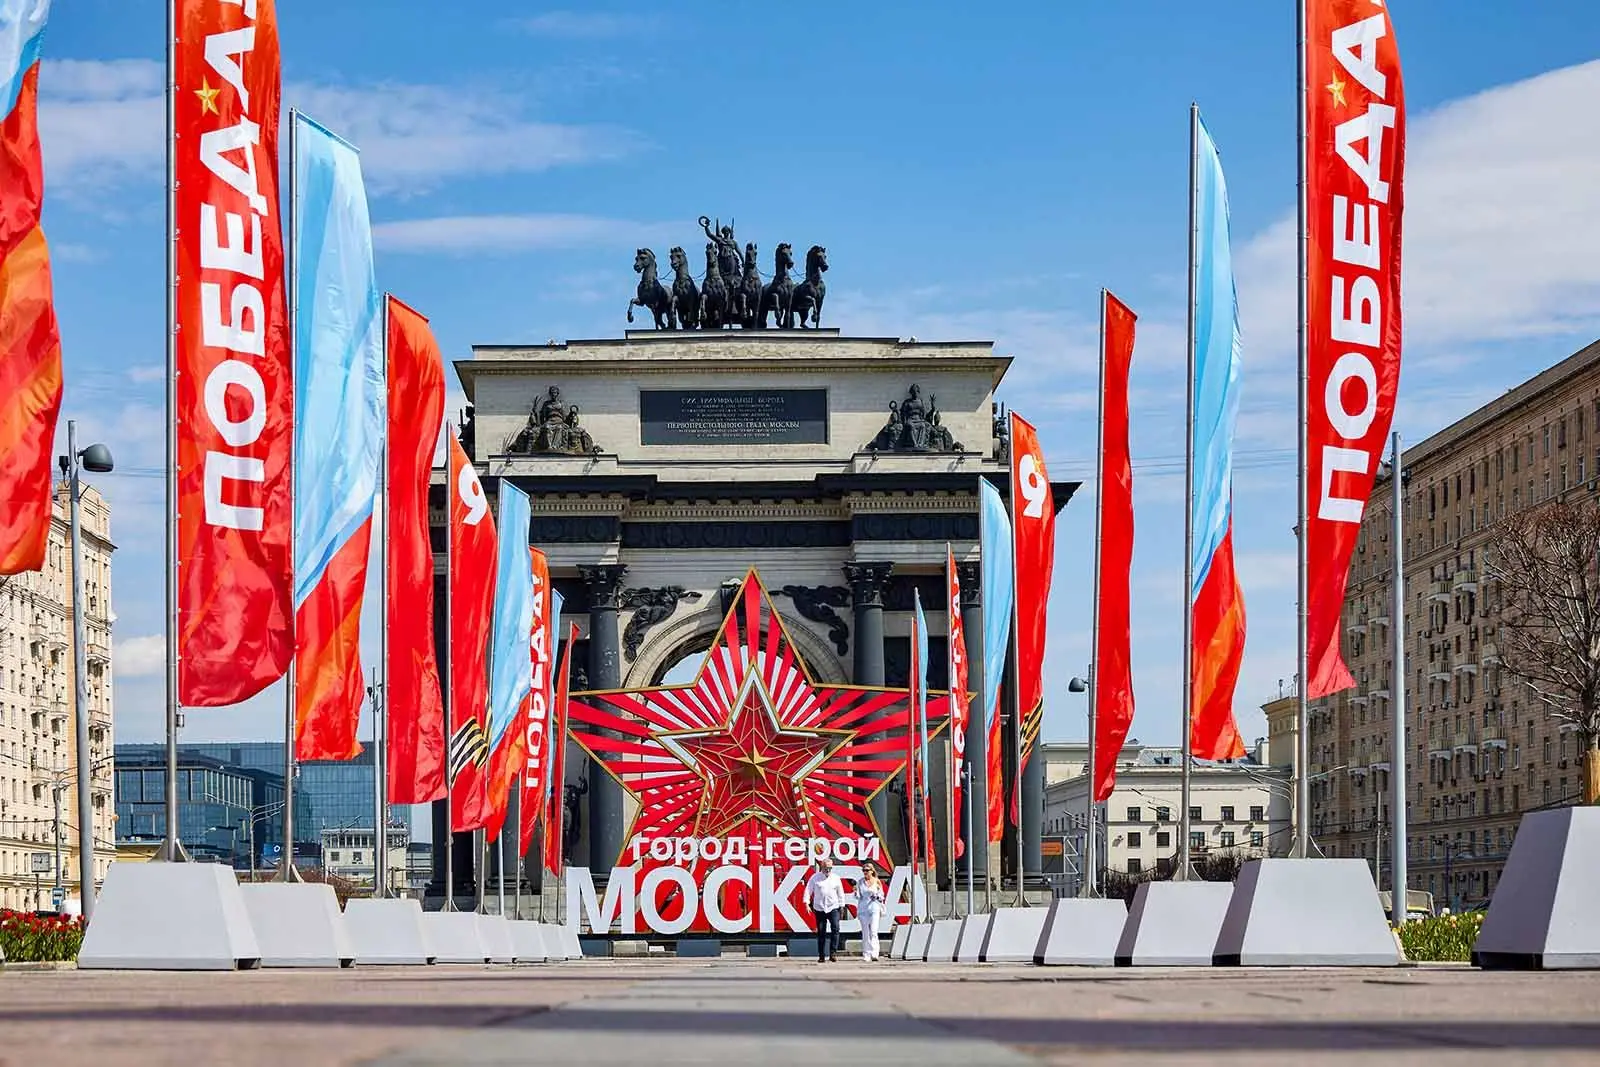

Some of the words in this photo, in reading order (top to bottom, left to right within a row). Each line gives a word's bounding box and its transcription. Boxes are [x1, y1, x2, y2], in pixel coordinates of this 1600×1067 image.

[1317, 0, 1396, 524] ПОБЕДА
[458, 463, 488, 525] 9
[1019, 454, 1047, 519] 9
[633, 832, 880, 866] город-герой
